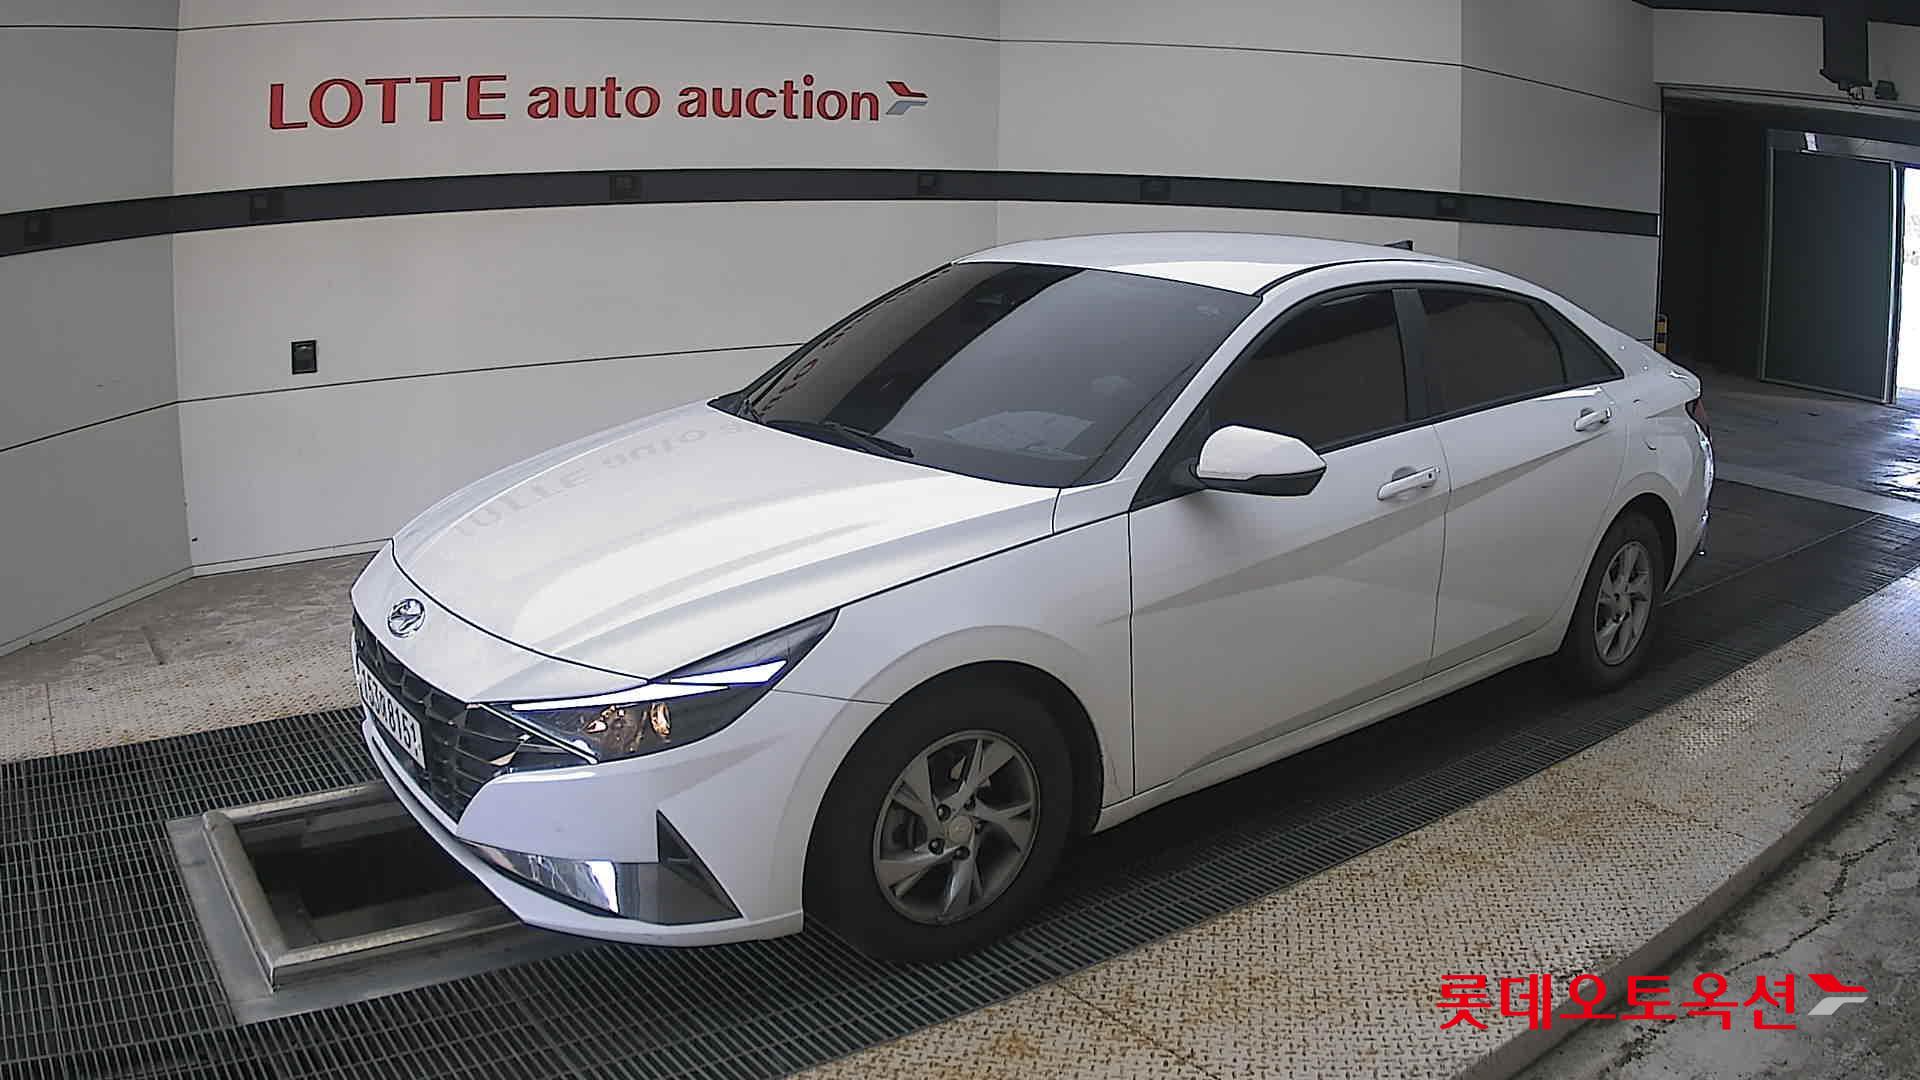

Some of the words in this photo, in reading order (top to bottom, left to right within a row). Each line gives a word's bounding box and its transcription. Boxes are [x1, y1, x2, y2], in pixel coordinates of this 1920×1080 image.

[269, 75, 507, 130] LOTTE
[527, 77, 660, 119] auto
[677, 74, 879, 121] auction
